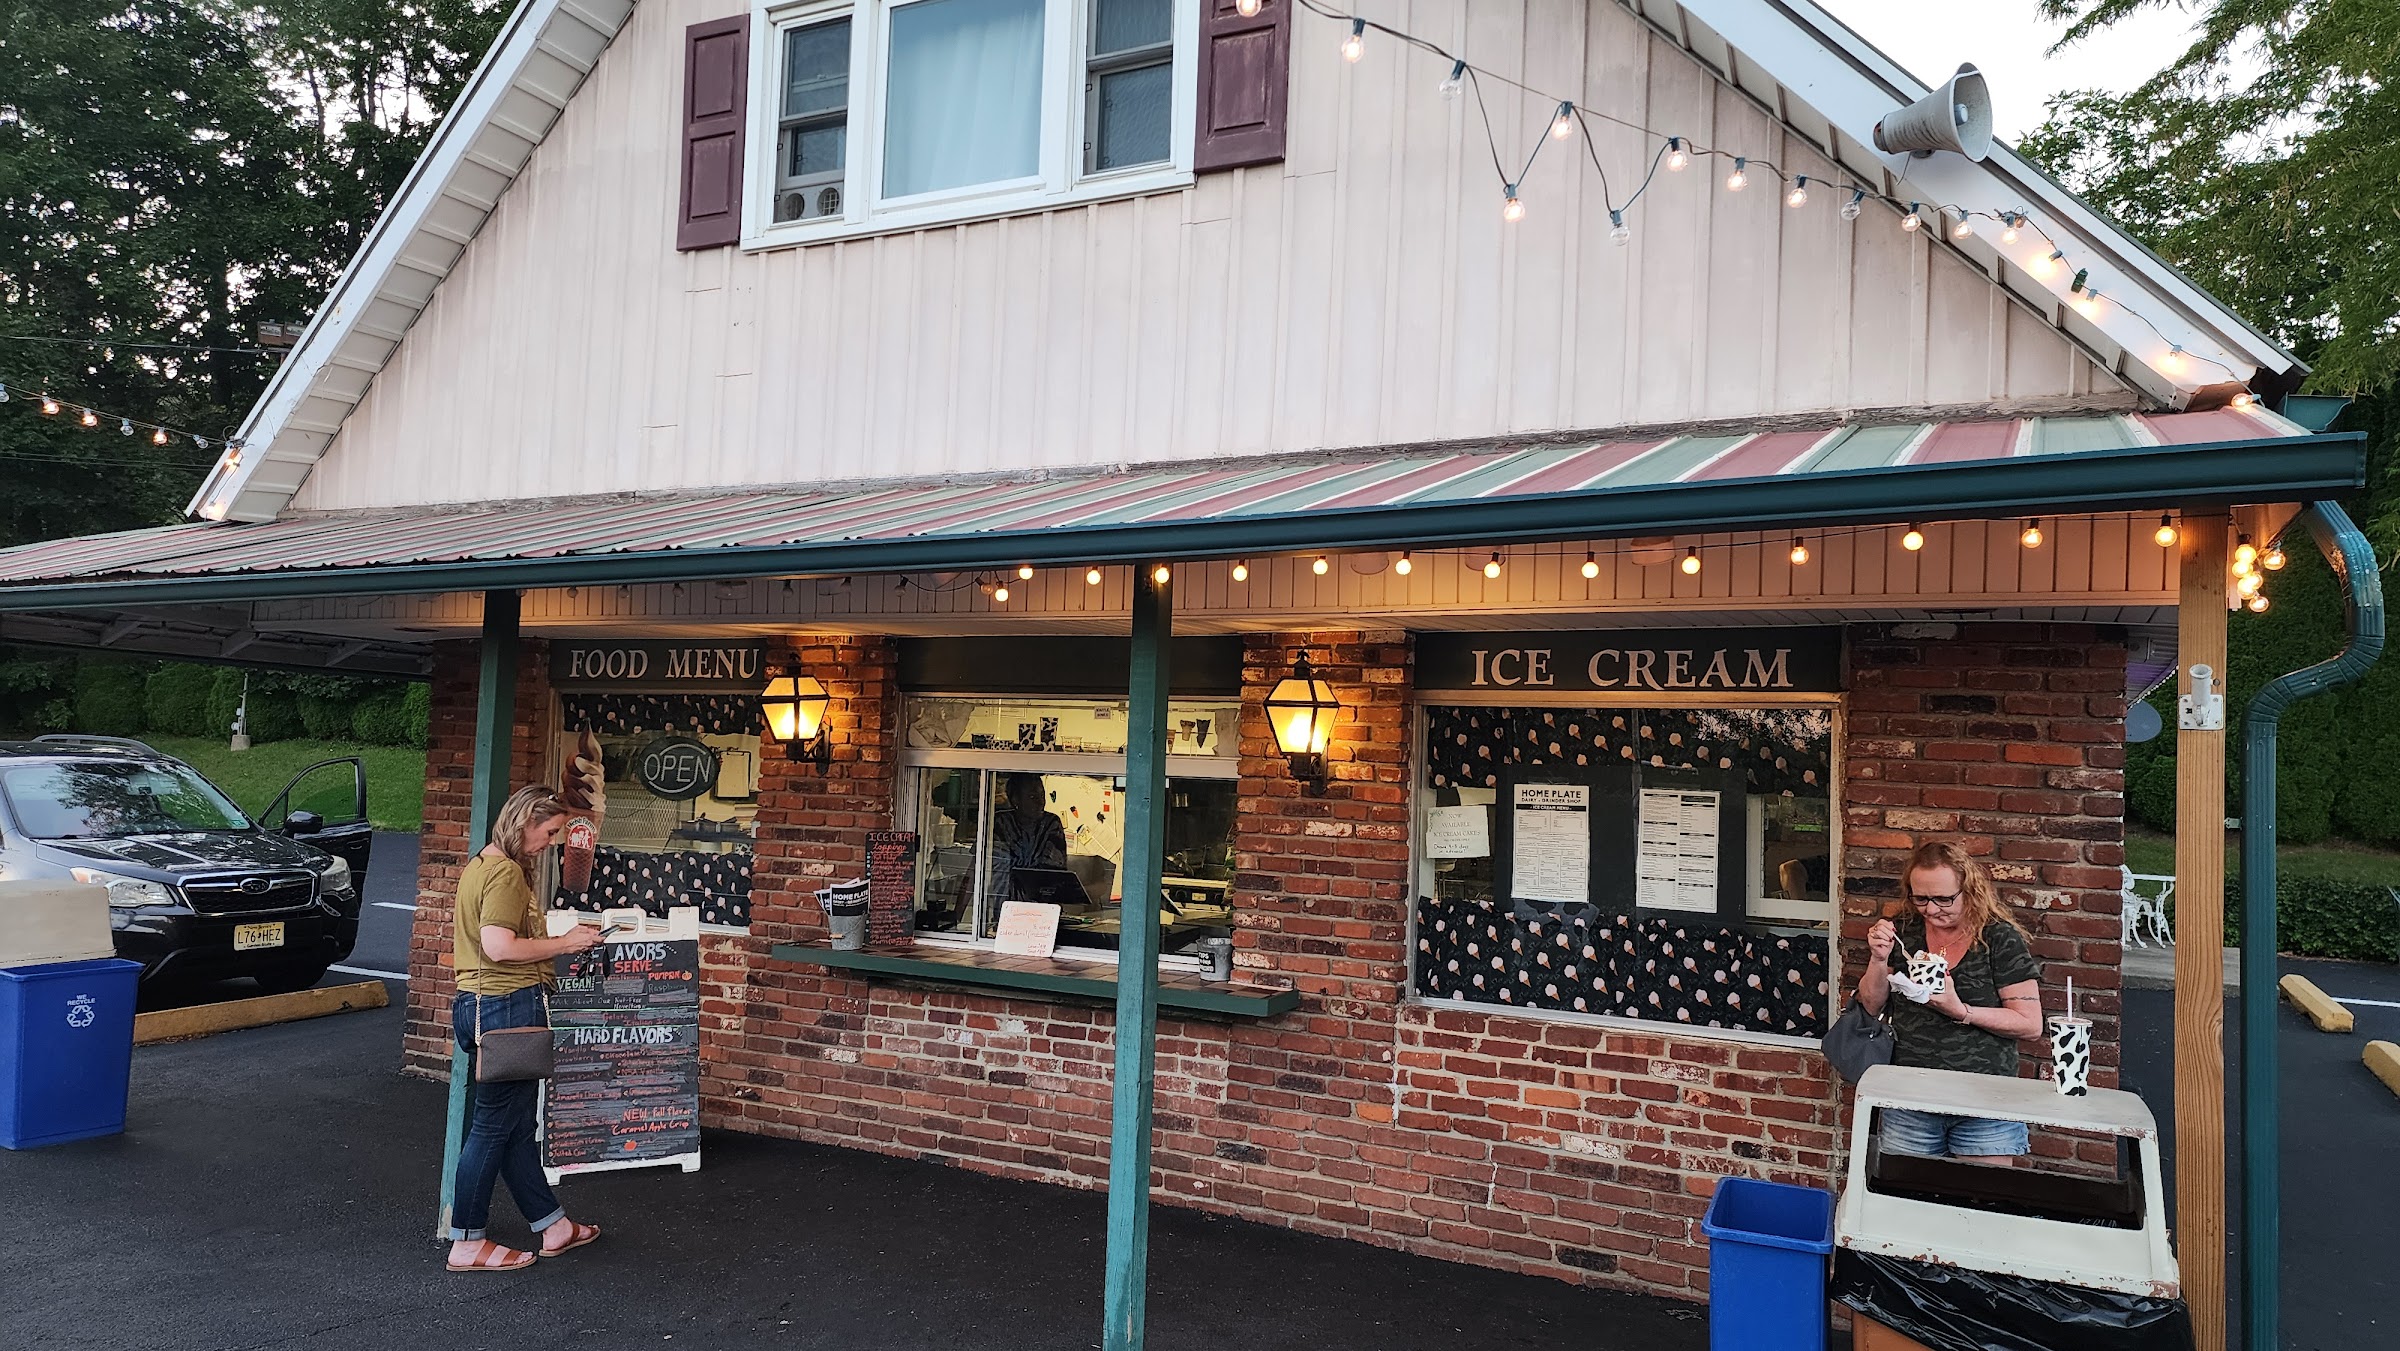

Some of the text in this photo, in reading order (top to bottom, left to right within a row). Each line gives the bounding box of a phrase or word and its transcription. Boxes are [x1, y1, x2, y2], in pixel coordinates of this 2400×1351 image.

[569, 649, 759, 679] FOOD MENU
[1471, 648, 1794, 690] ICE CREAM
[645, 754, 712, 782] OPEN
[1521, 789, 1581, 798] HOME PLATE
[869, 832, 889, 841] ICE
[569, 960, 652, 976] ST SERVE
[648, 971, 680, 980] PUMPKIN
[67, 998, 95, 1006] RECYCLE
[574, 1026, 674, 1045] HARD FLAVORS
[623, 1108, 648, 1121] NEW
